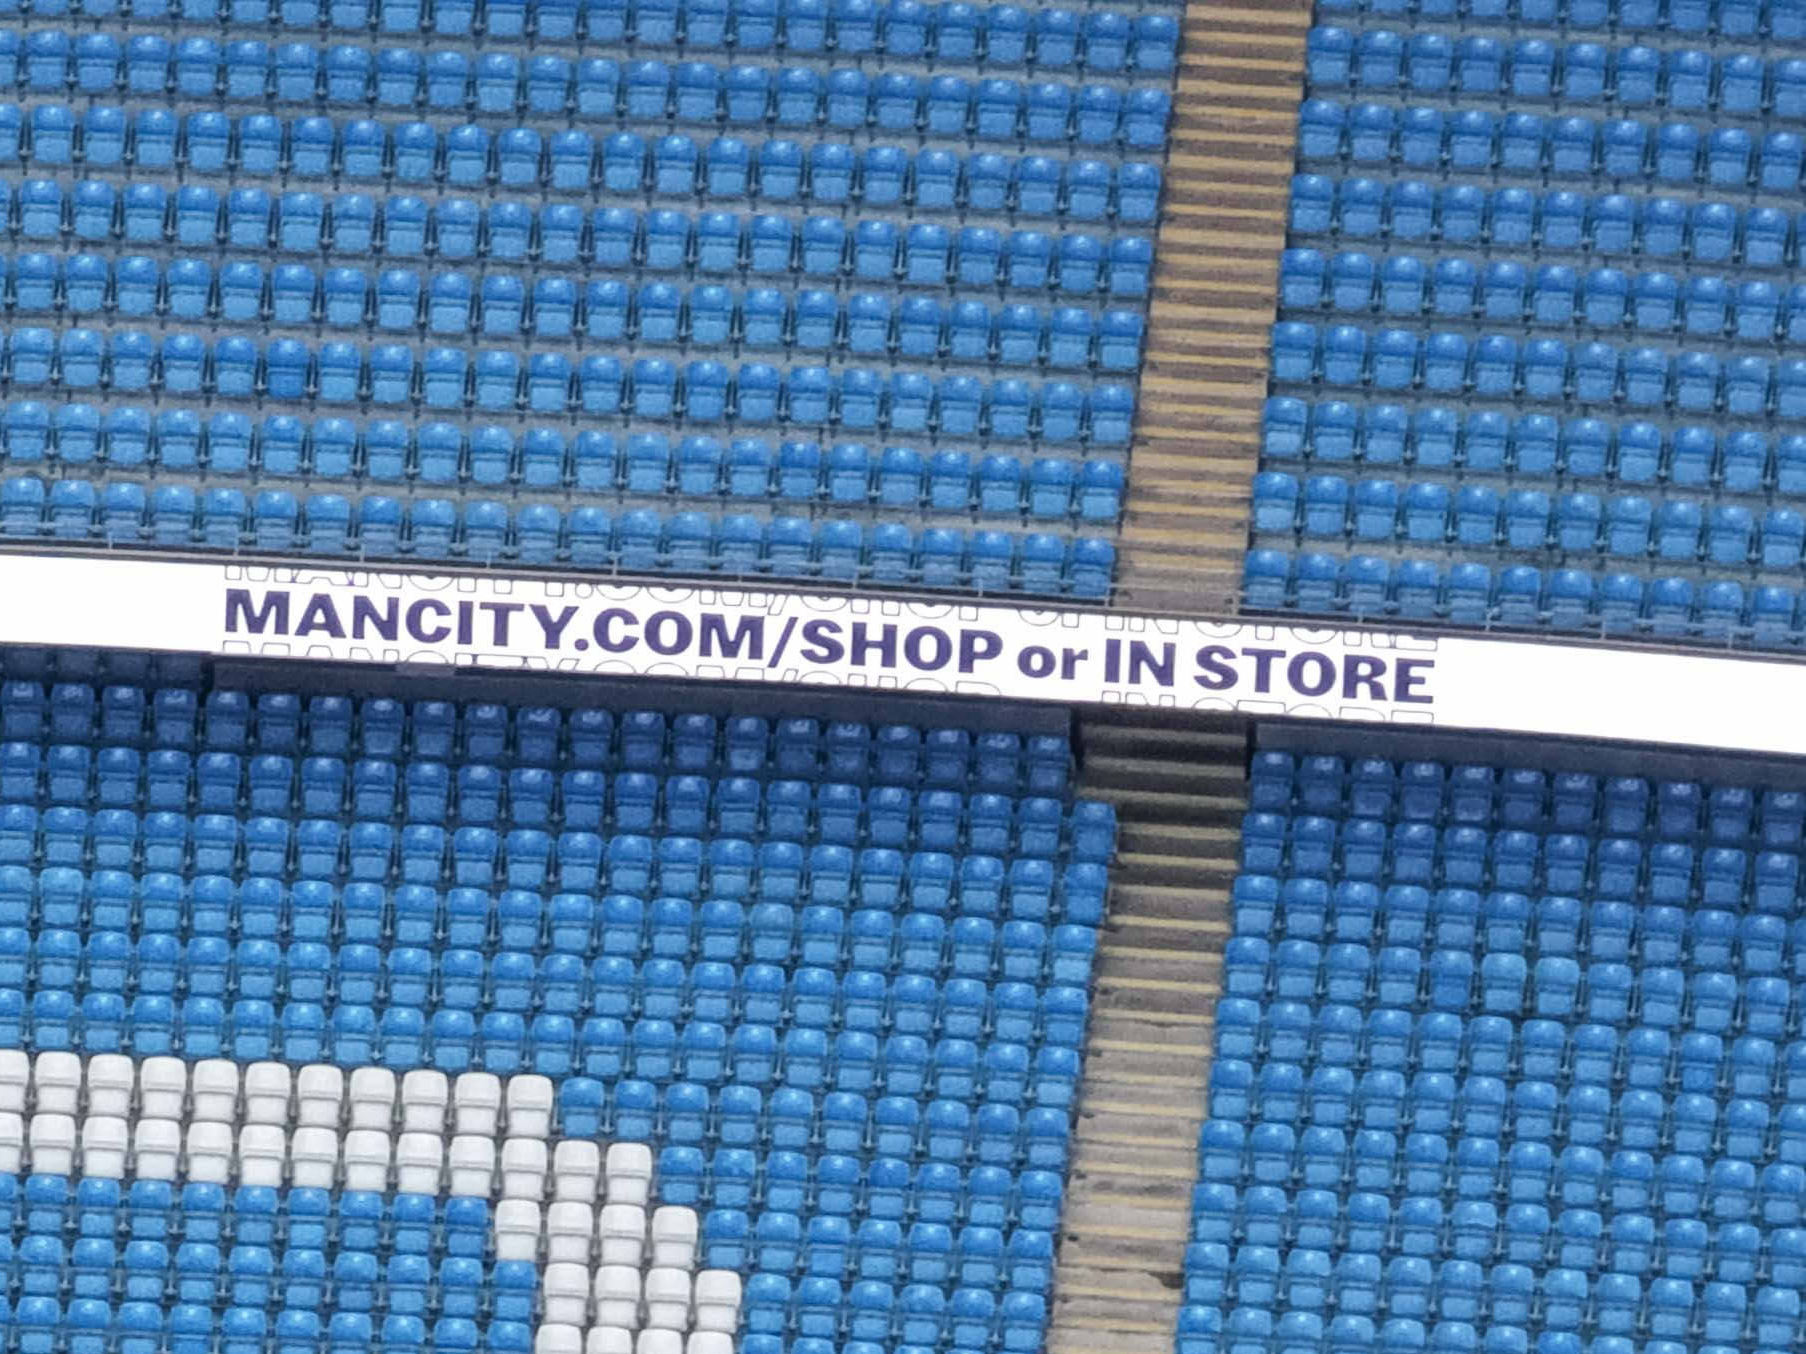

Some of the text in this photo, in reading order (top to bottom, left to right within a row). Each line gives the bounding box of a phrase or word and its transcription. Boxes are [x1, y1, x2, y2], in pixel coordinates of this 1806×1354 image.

[225, 588, 1005, 674] MANCITY.COM/SHOP
[1017, 646, 1089, 681] or
[1104, 638, 1177, 688] IN
[1194, 645, 1437, 705] STORE
